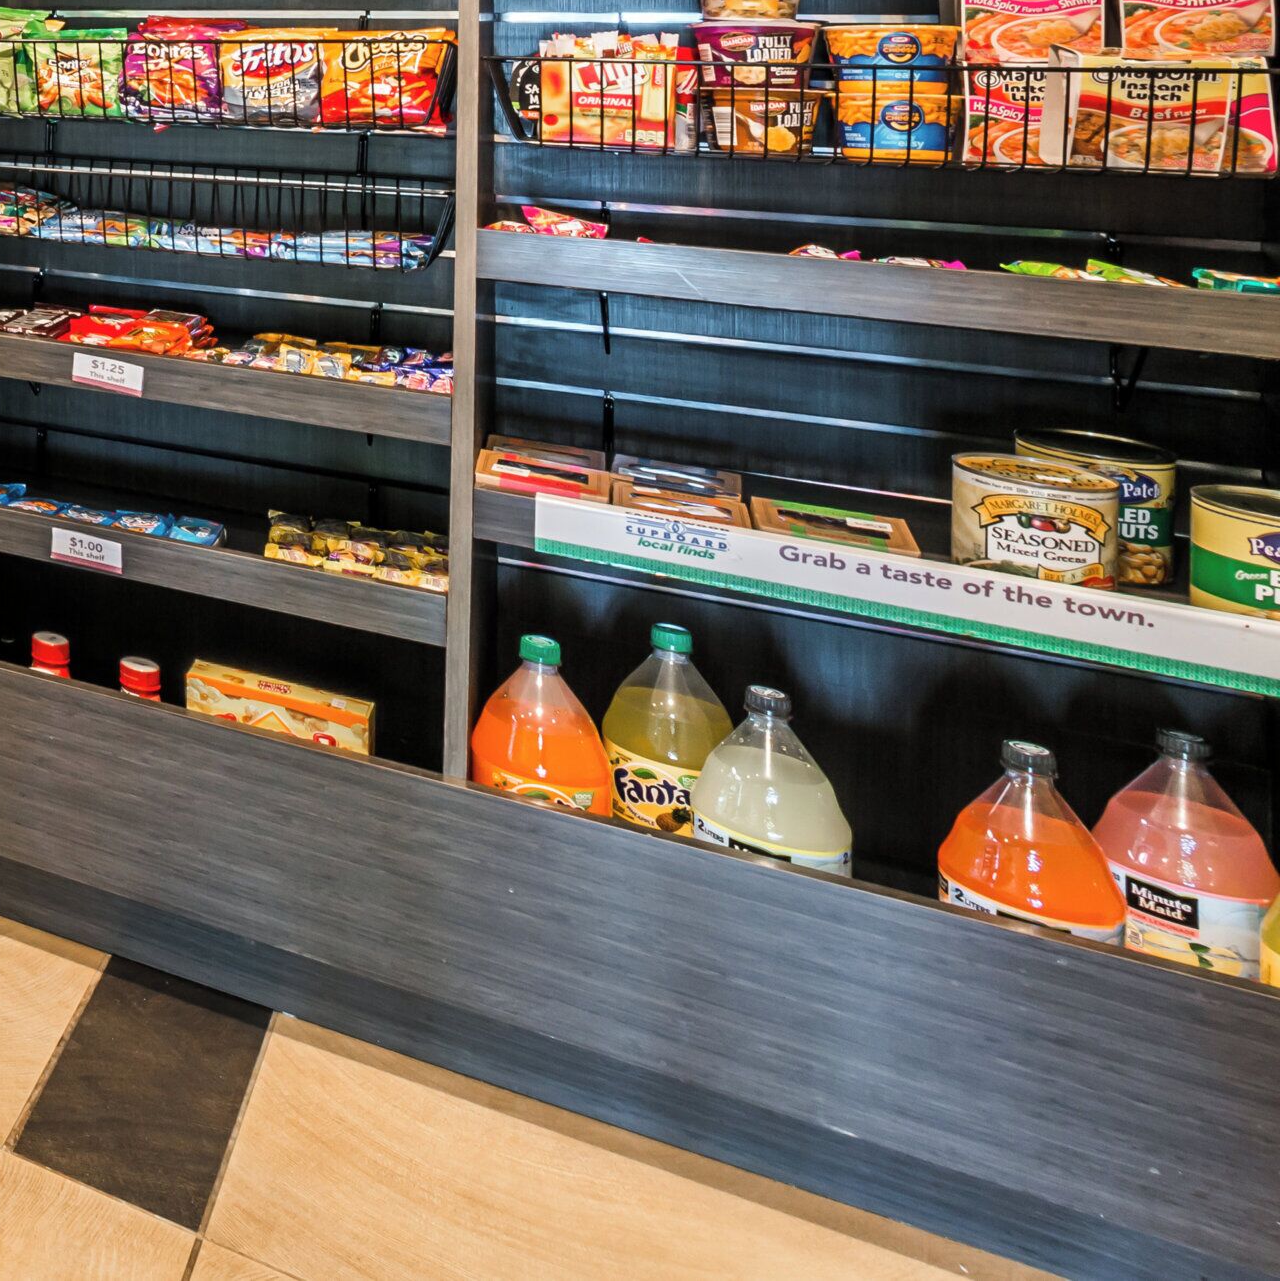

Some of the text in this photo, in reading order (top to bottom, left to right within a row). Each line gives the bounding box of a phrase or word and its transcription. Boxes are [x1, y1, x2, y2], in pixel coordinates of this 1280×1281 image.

[758, 35, 792, 49] FULLY
[230, 42, 316, 76] Fritos
[746, 47, 791, 63] LOADED
[1121, 81, 1191, 93] Instant
[578, 96, 633, 106] ORIGINAL
[1127, 91, 1181, 102] Lunch
[91, 359, 125, 375] $1.25
[89, 370, 125, 385] This shelf
[1123, 482, 1161, 499] Patch
[990, 495, 1050, 513] MARGARET
[69, 538, 103, 553] $1.00
[625, 525, 729, 551] CUPBOARD
[992, 526, 1095, 553] SEASONED
[68, 547, 105, 562] This shelf
[638, 537, 715, 560] local finds
[996, 541, 1087, 565] Mixed Greens
[779, 545, 1154, 628] Grab a taste of the town.
[698, 819, 724, 843] 2 LITERS
[954, 888, 991, 915] 2 LITERS
[1131, 882, 1192, 913] Minute
[1139, 898, 1183, 921] Maid
